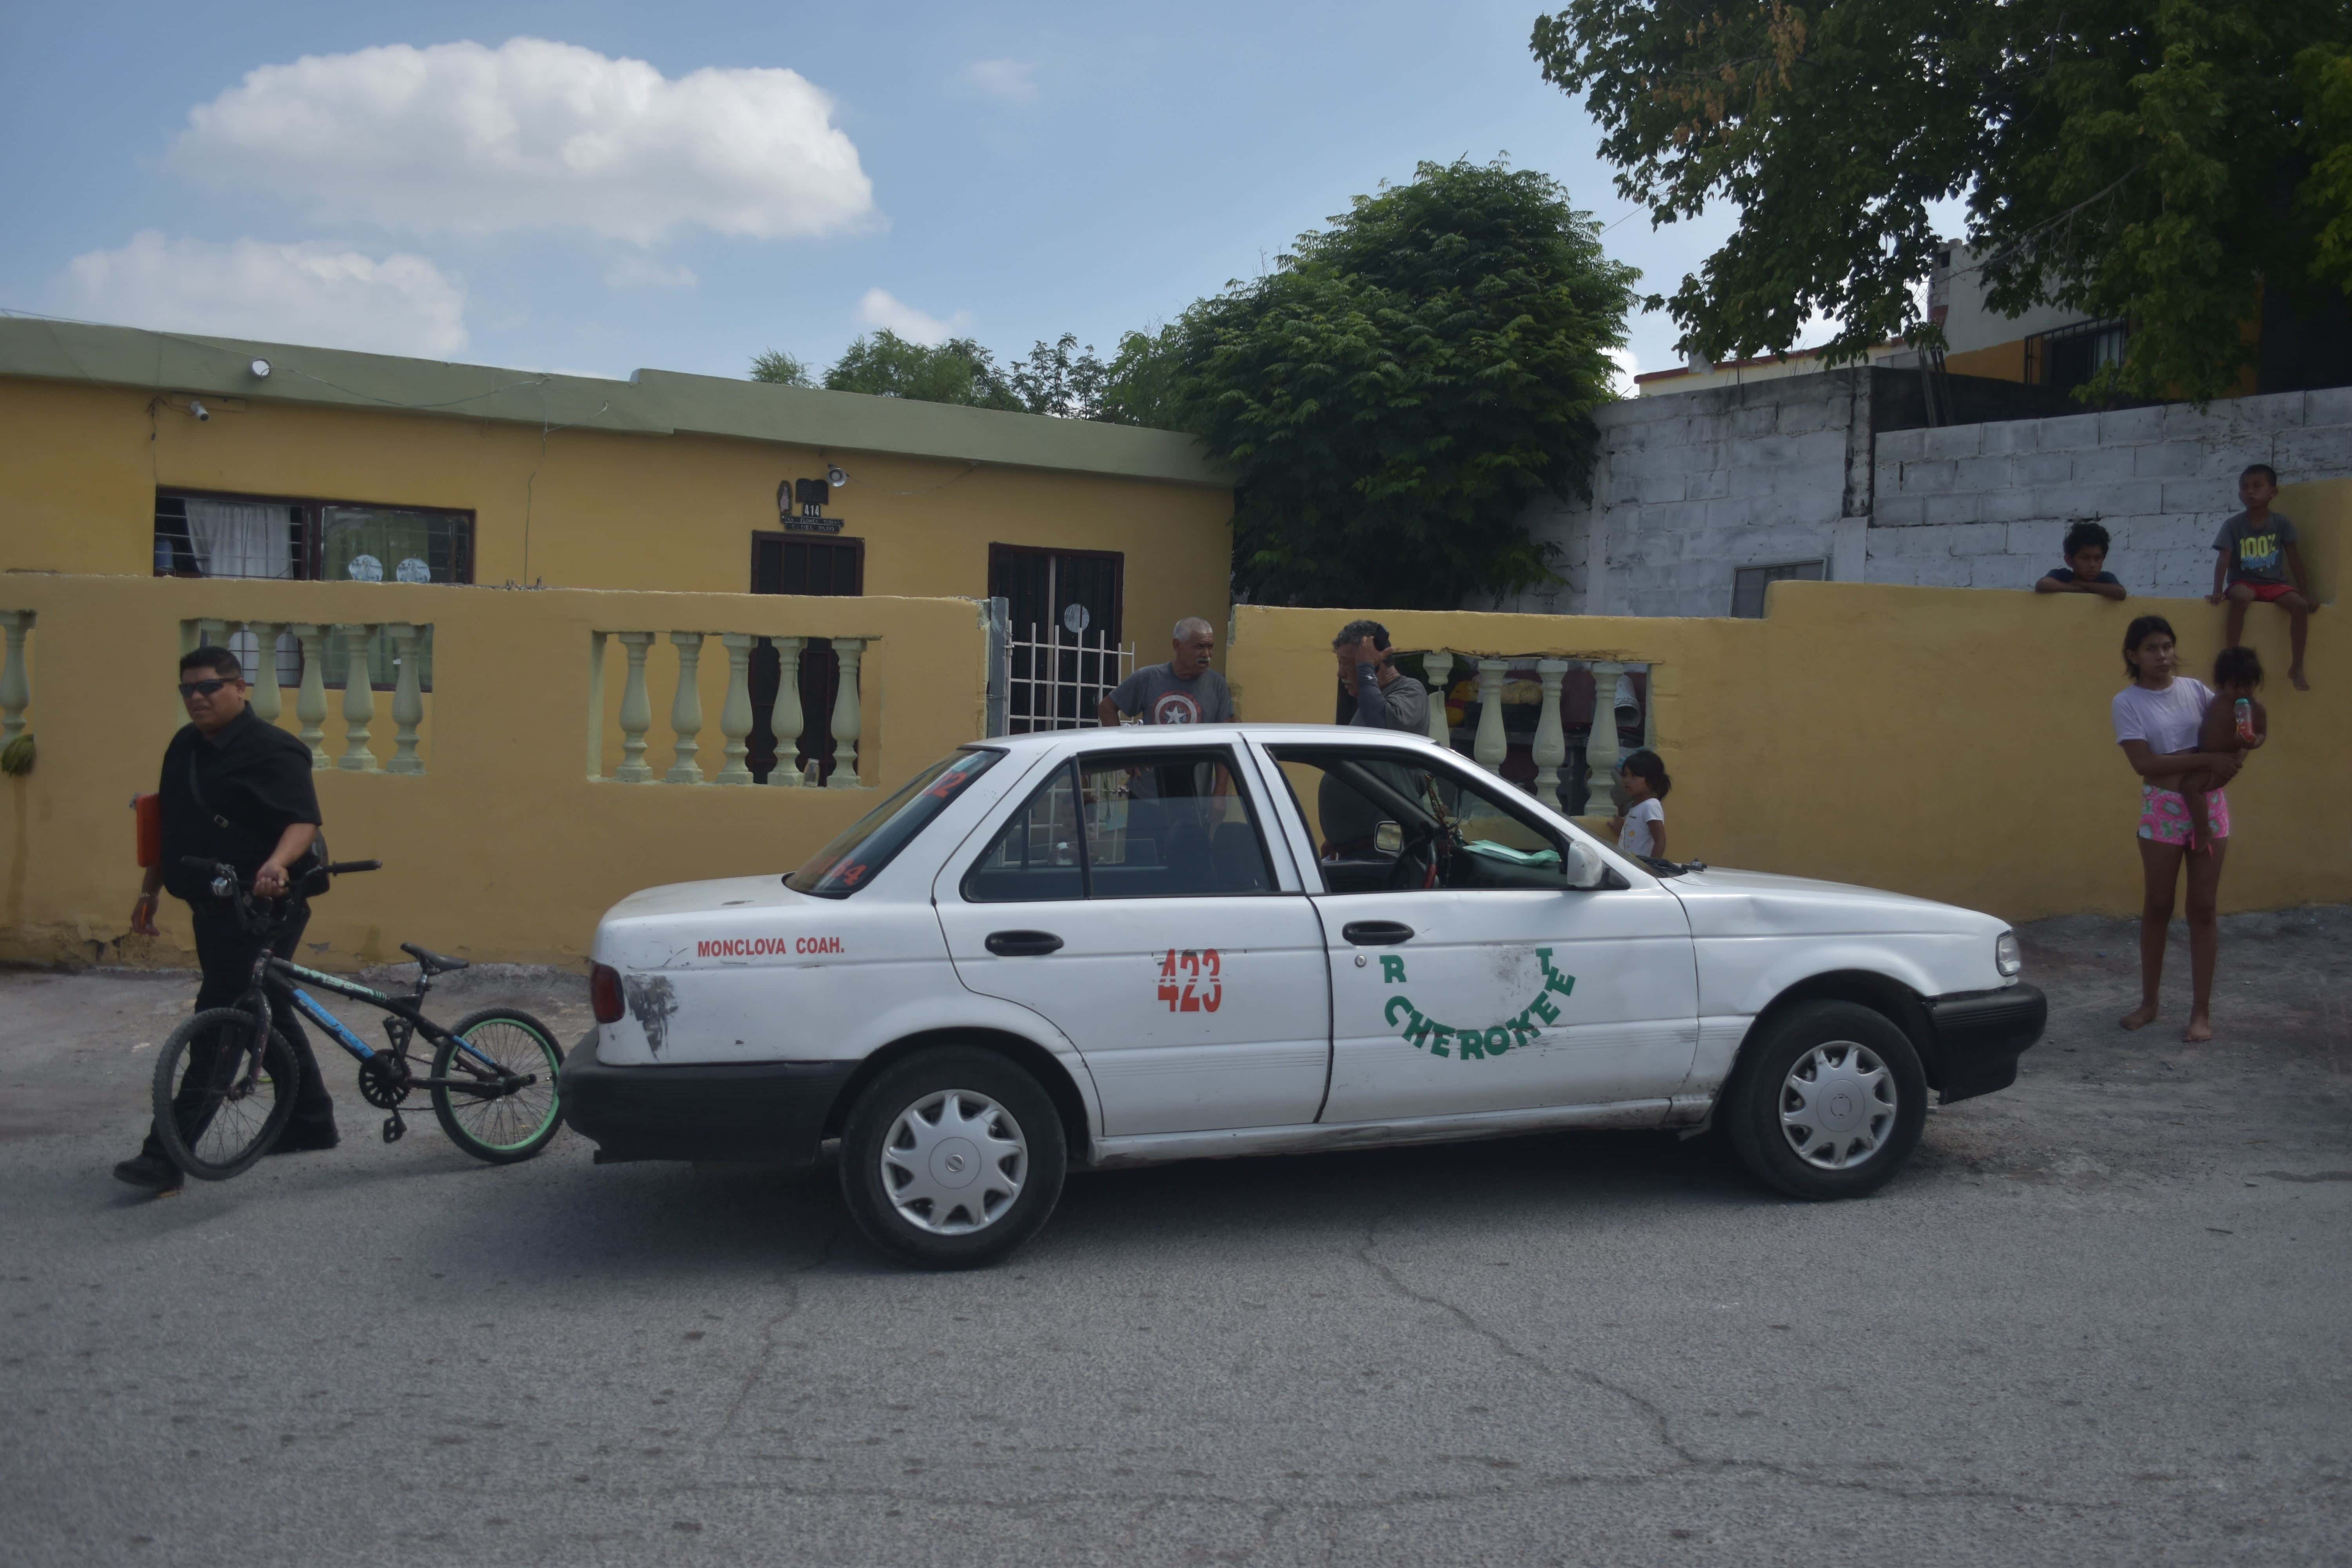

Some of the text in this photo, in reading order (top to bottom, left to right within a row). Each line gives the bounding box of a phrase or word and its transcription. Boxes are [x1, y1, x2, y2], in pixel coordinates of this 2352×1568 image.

[804, 504, 820, 517] 414
[2239, 534, 2277, 559] 100%
[698, 936, 845, 957] MONCLOVA COAH.
[1158, 948, 1222, 1013] 423
[1384, 966, 1576, 1060] CHEROKEE
